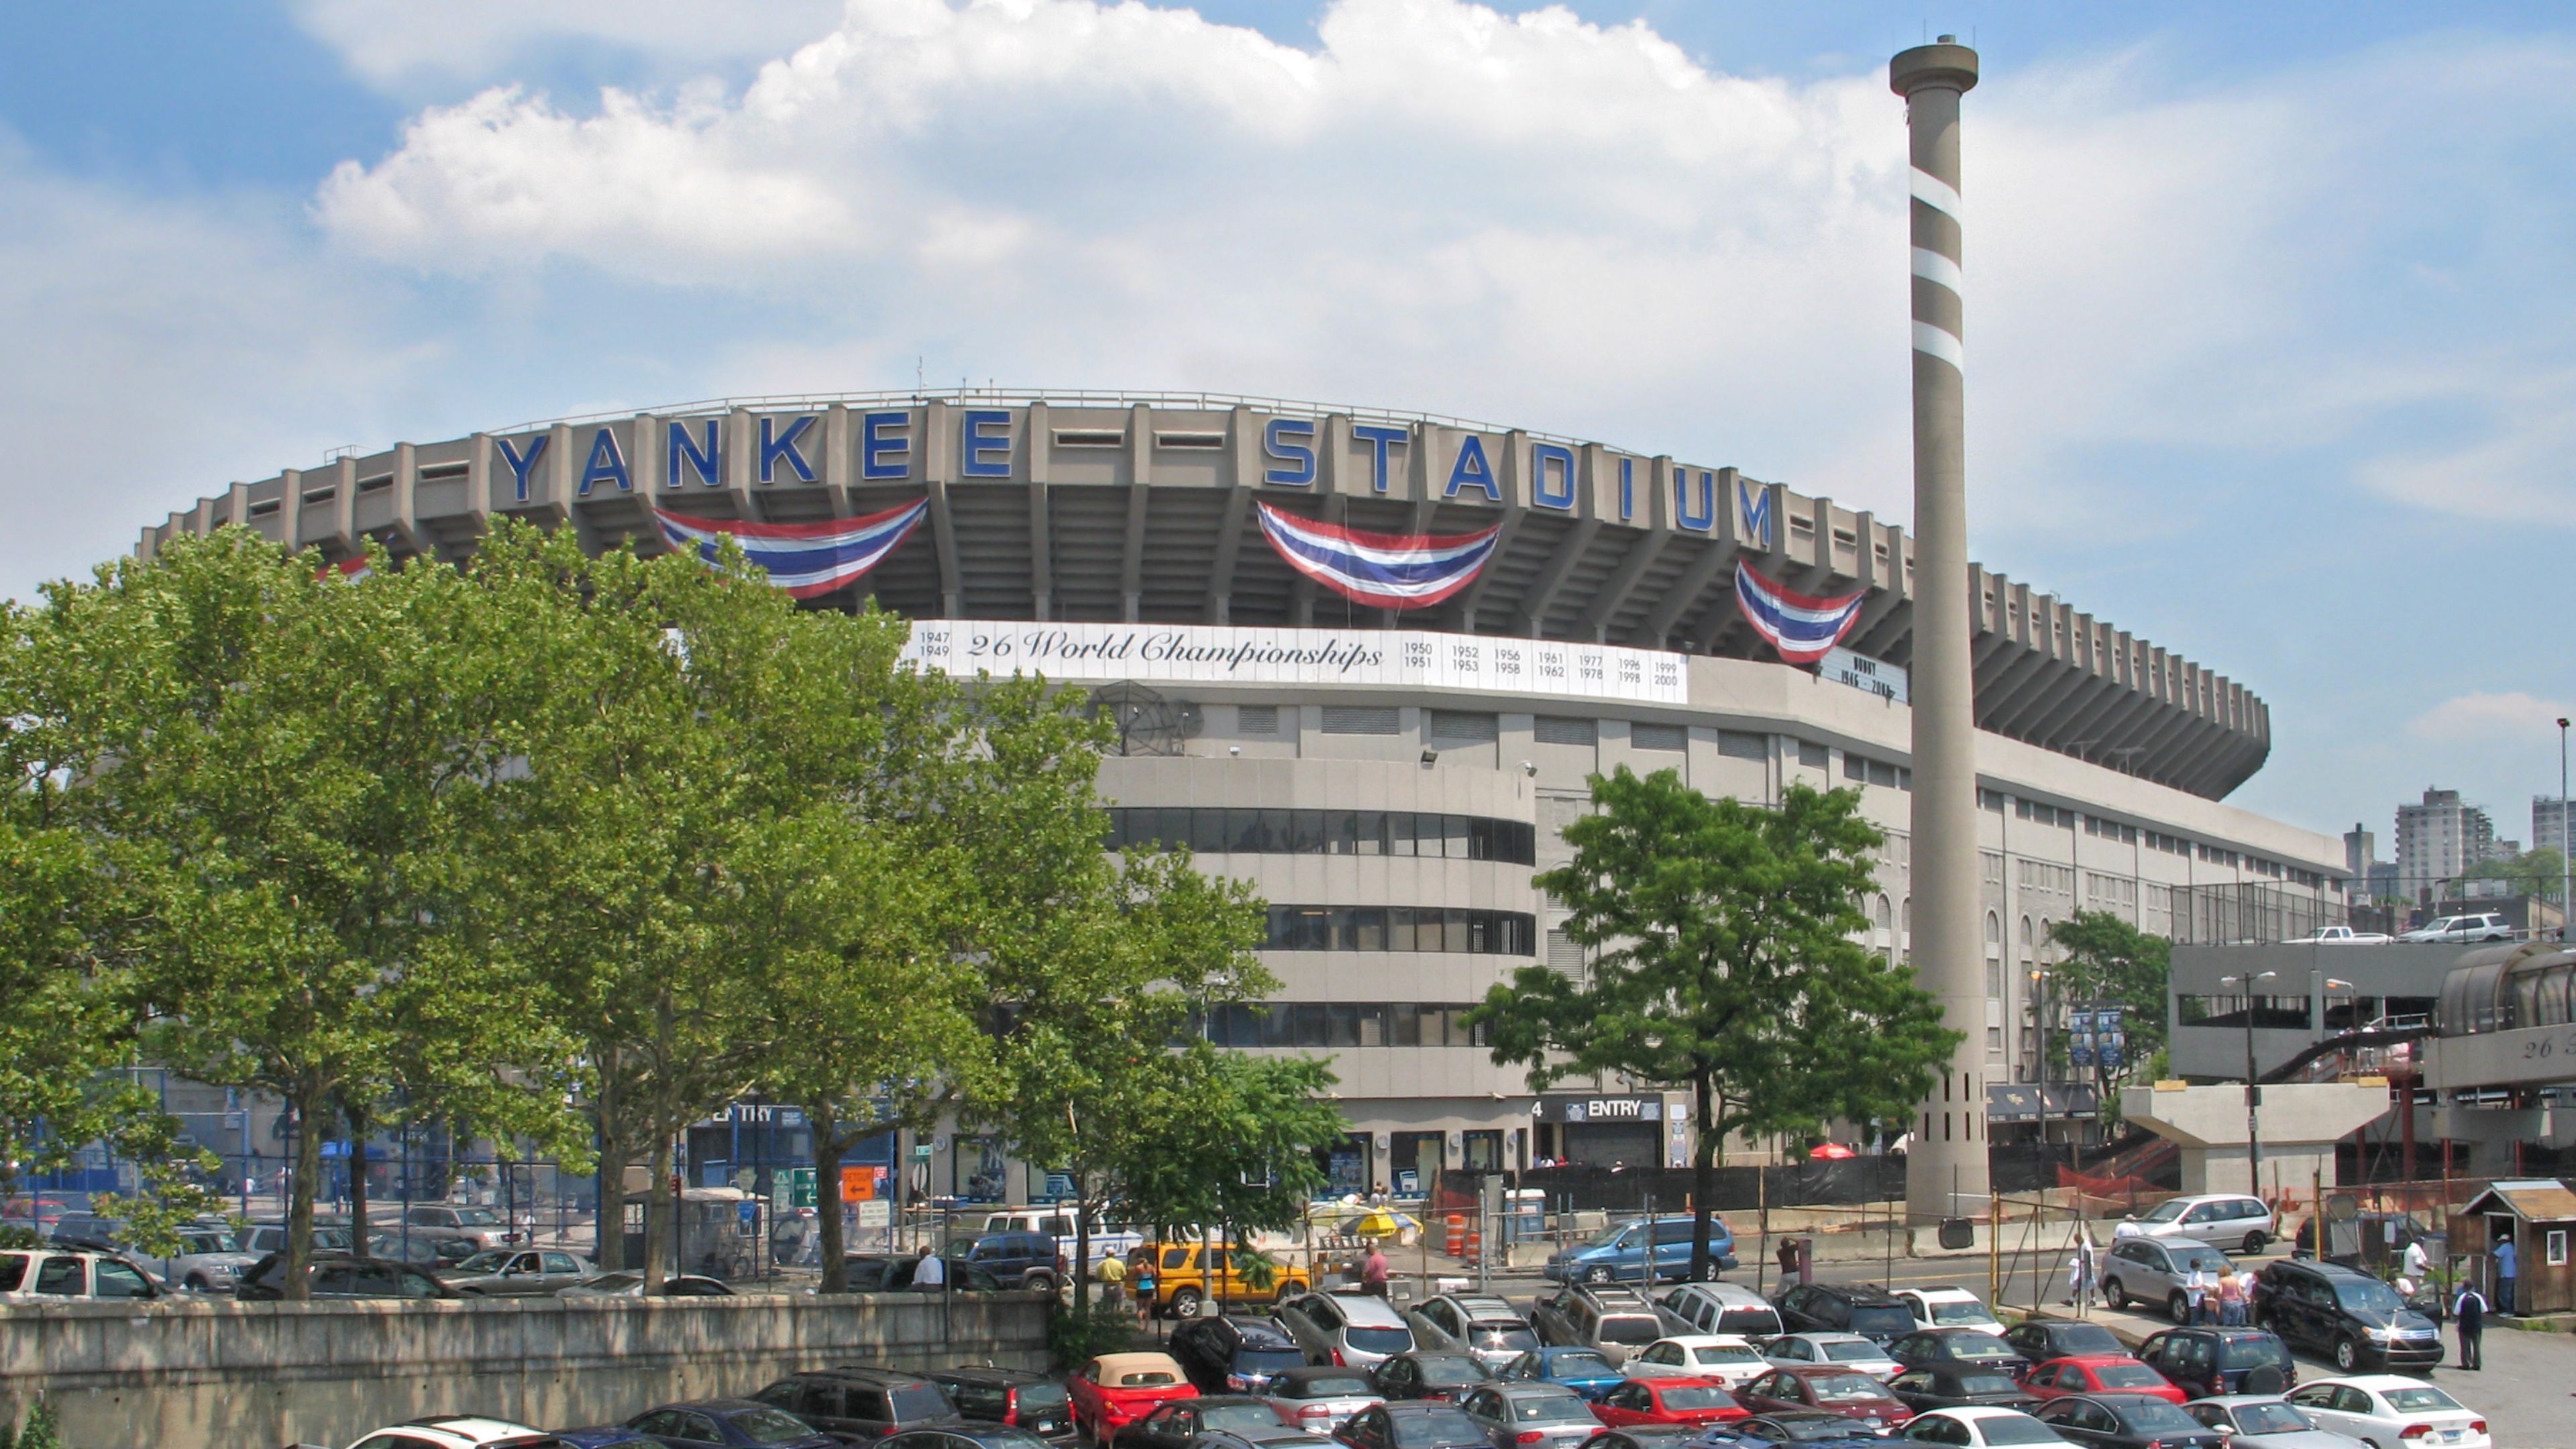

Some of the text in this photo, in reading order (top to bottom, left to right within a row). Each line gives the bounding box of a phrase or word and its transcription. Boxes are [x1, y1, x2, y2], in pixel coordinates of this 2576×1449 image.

[496, 411, 1772, 546] YANKEE STADIUM
[920, 632, 950, 643] 1947
[920, 645, 949, 657] 1949
[968, 631, 1383, 673] 26 World Championships
[1405, 643, 1676, 672] 1950 1952 1956 1961 1977 1996 1999
[1405, 656, 1677, 686] 1951 1953 1958 1962 1978 1998 2000
[2521, 1035, 2553, 1059] 26
[1532, 1101, 1543, 1117] 4
[1589, 1099, 1641, 1117] ENTRY
